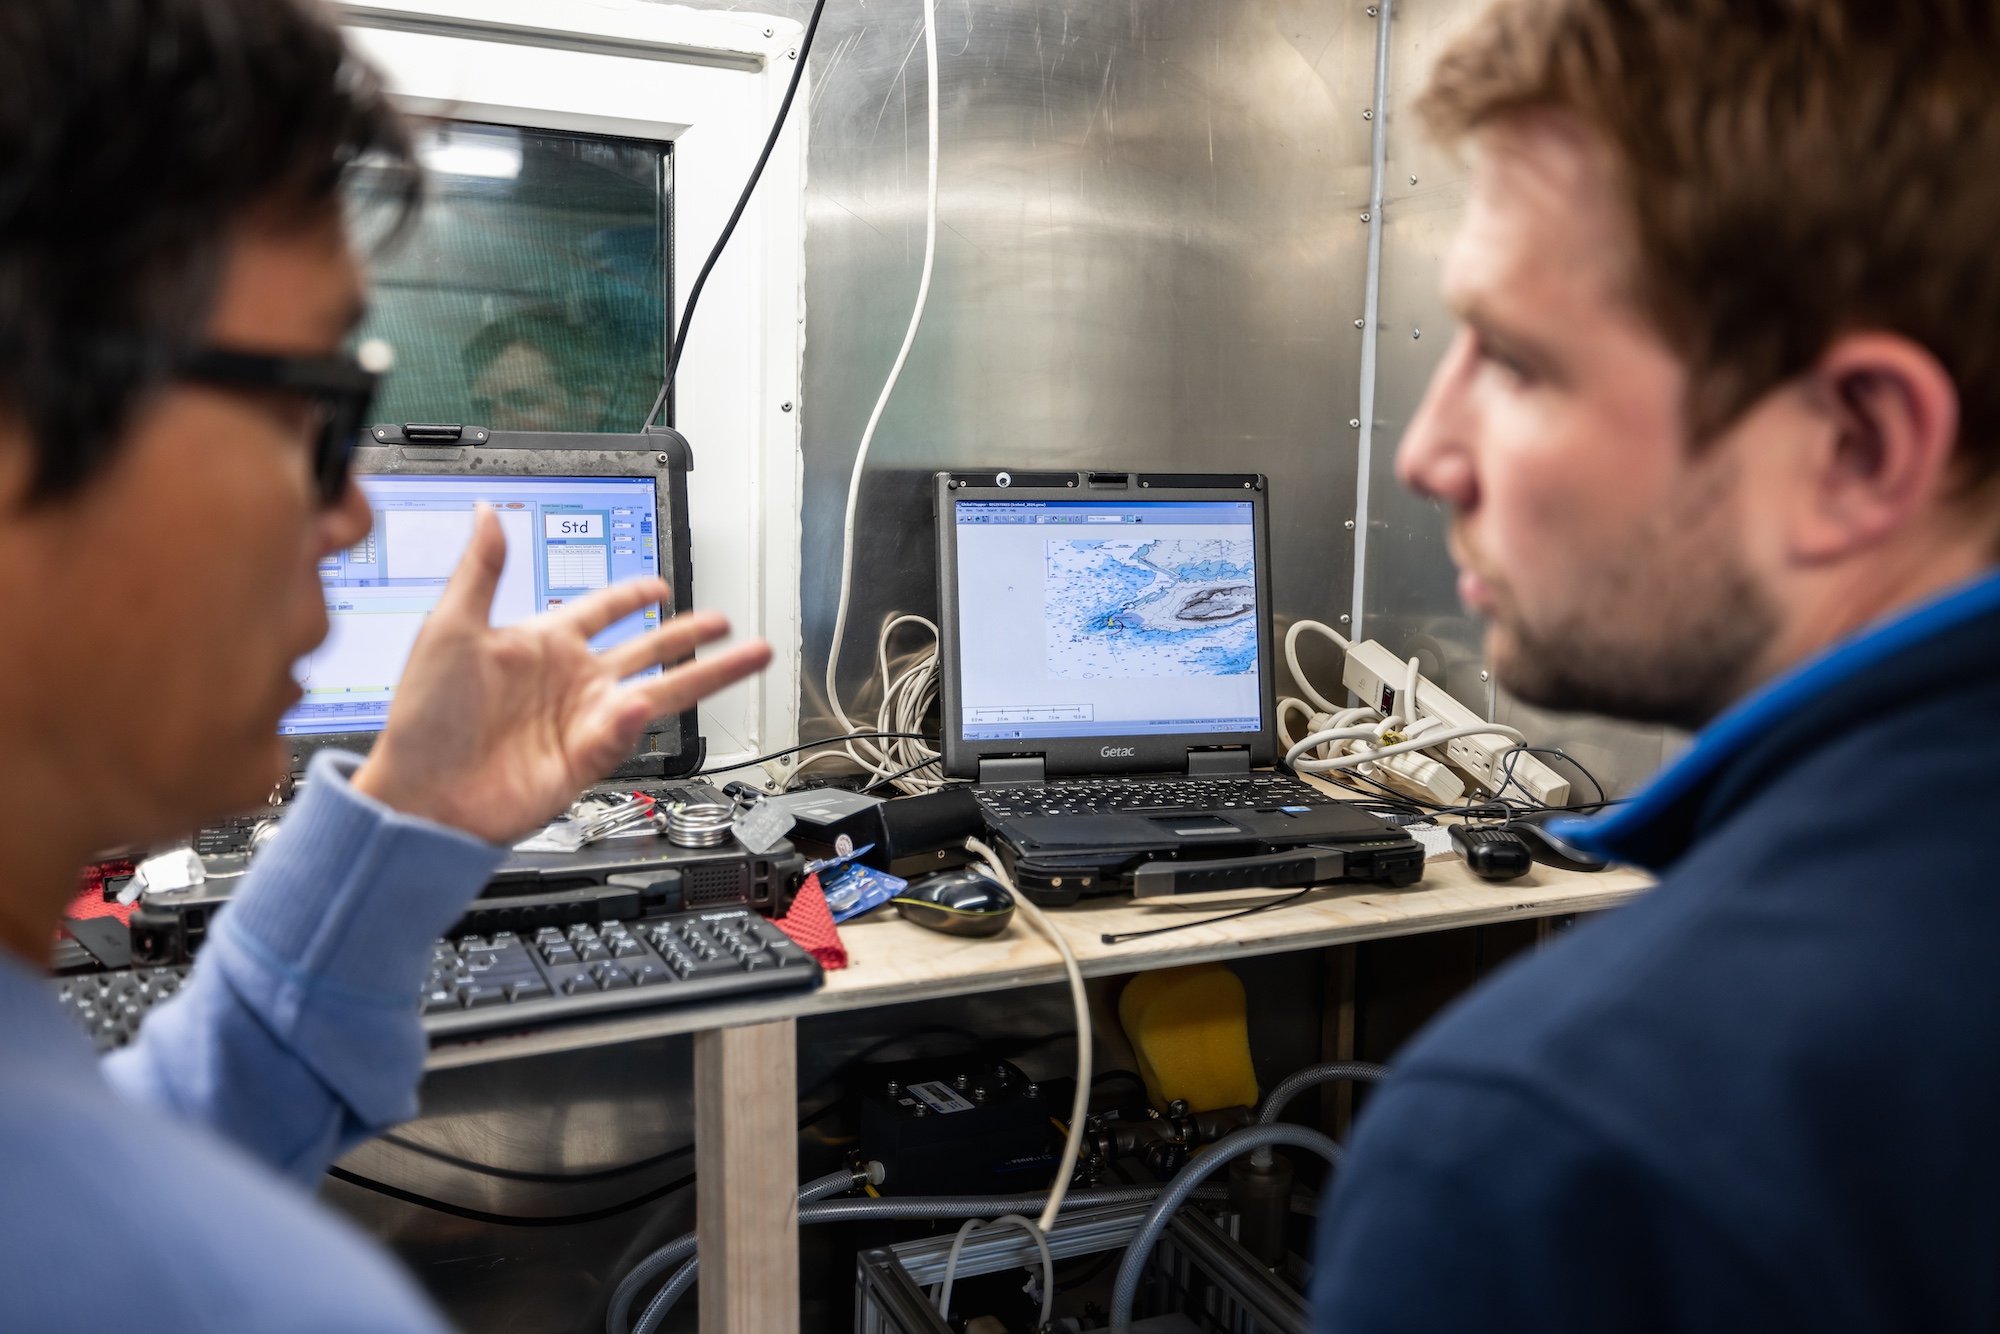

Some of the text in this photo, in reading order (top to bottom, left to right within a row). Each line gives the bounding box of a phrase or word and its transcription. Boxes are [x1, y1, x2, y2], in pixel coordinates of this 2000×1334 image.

[561, 520, 588, 533] Std
[1100, 746, 1134, 757] Getac
[700, 910, 748, 920] logitech
